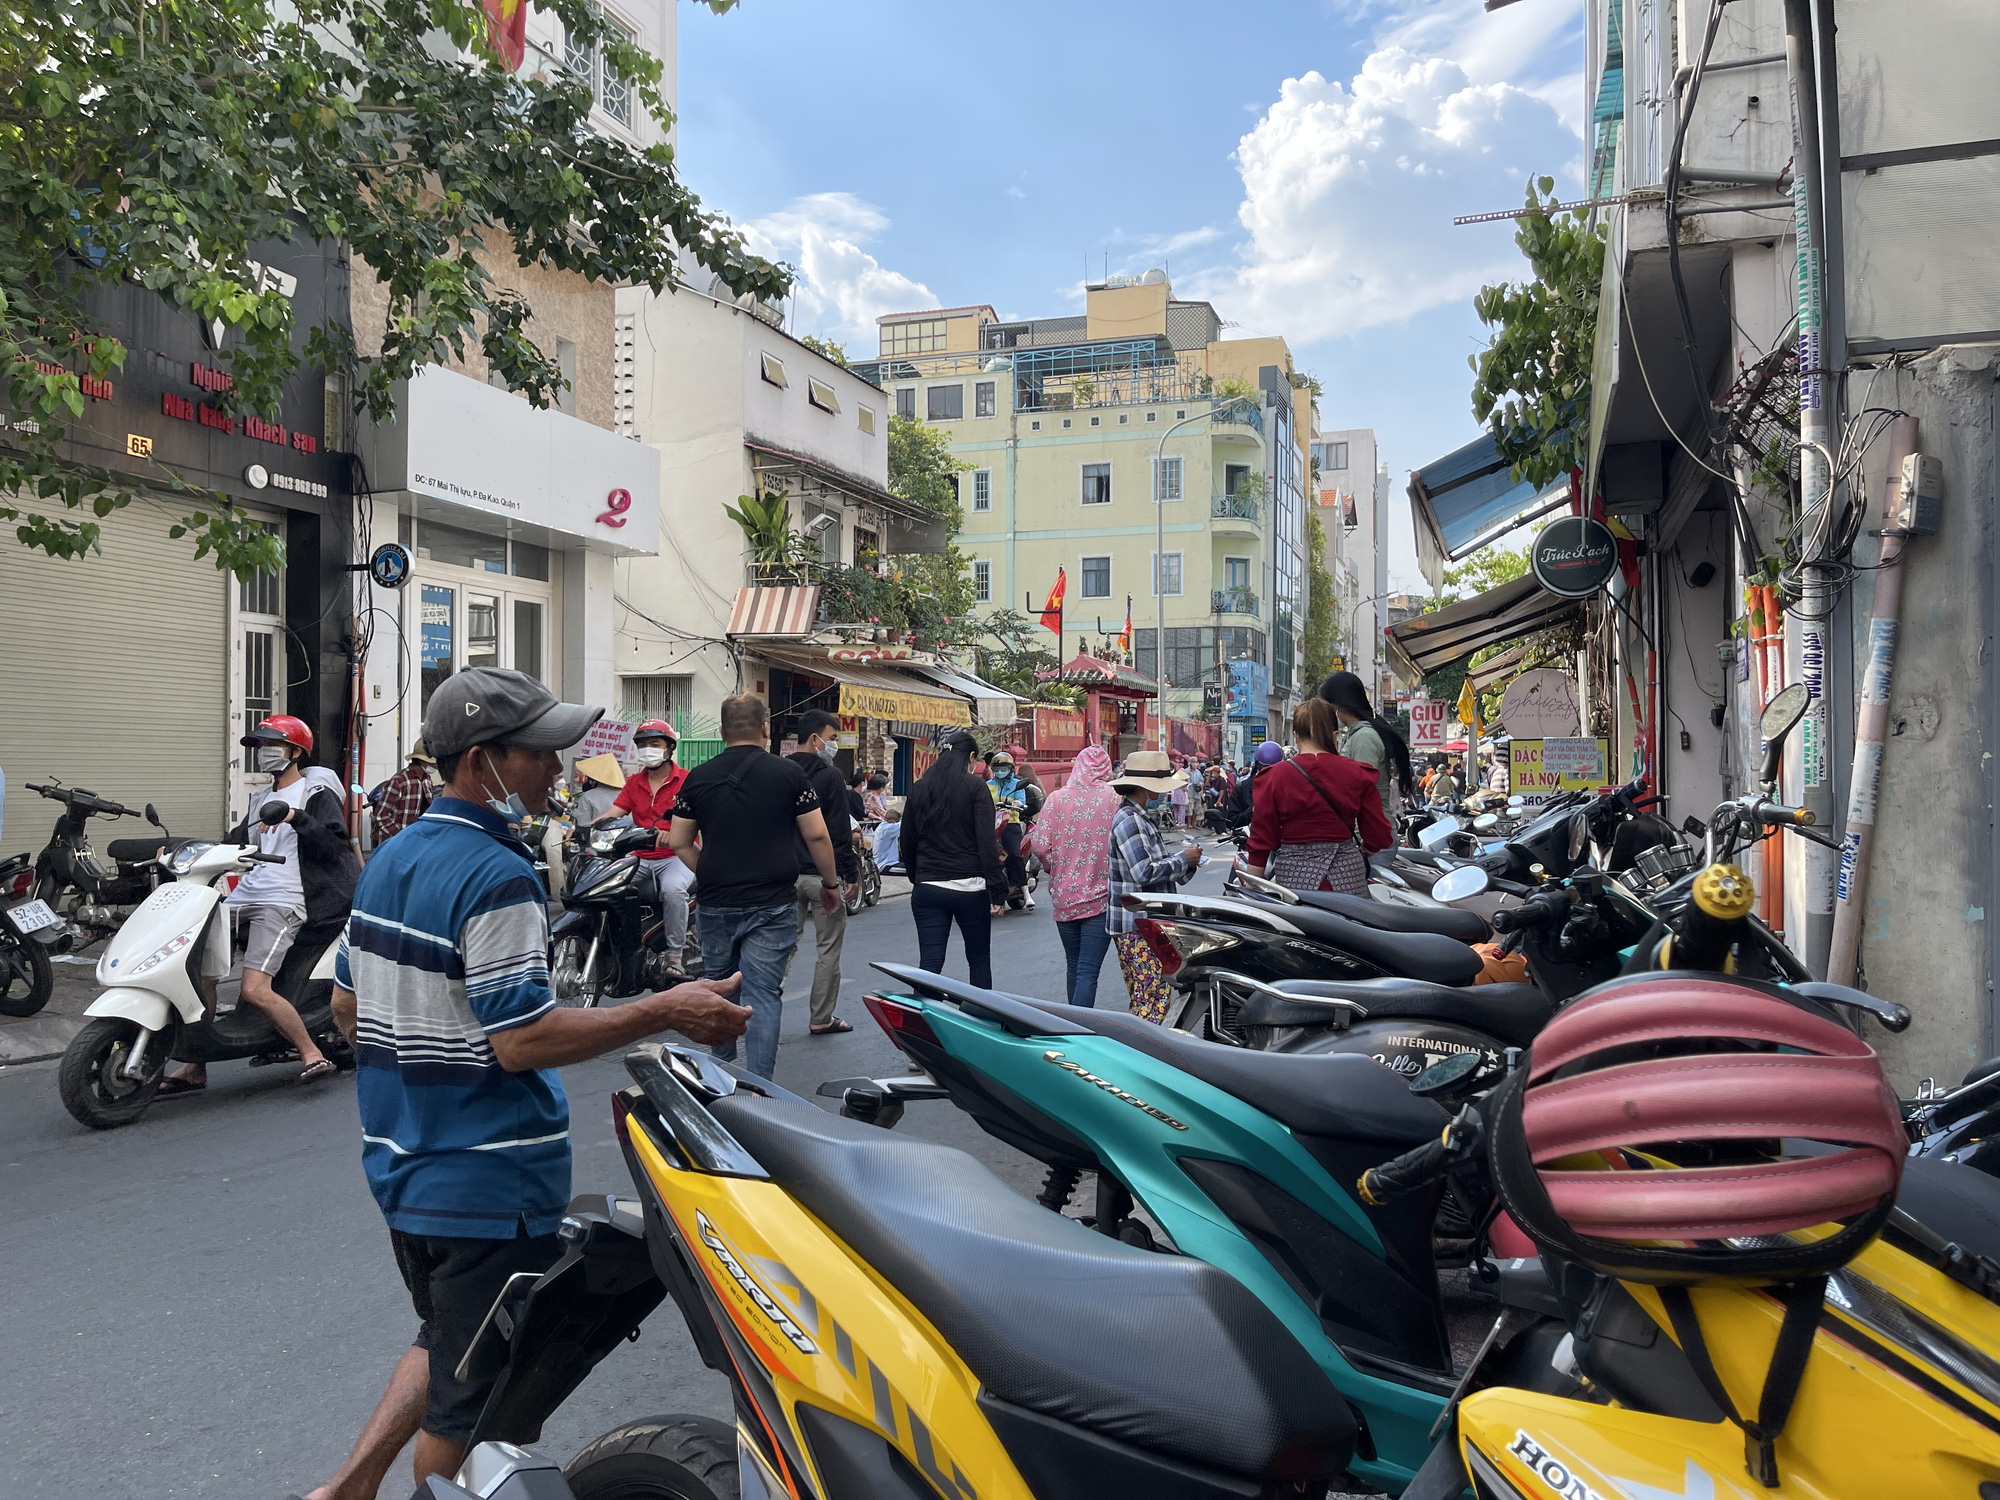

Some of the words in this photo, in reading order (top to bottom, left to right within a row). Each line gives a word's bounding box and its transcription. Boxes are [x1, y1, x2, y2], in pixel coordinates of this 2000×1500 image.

[131, 437, 148, 455] 65
[273, 473, 294, 491] 0913
[295, 478, 311, 495] 868
[311, 483, 328, 499] 999
[428, 477, 437, 487] 67
[437, 480, 449, 491] Mai
[516, 502, 521, 510] 1
[1541, 547, 1571, 563] Trúc
[1411, 701, 1446, 722] GIỮ
[1416, 724, 1441, 739] XE
[1514, 746, 1538, 765] ĐẶC
[1519, 769, 1536, 786] HÀ
[22, 913, 52, 931] 2303
